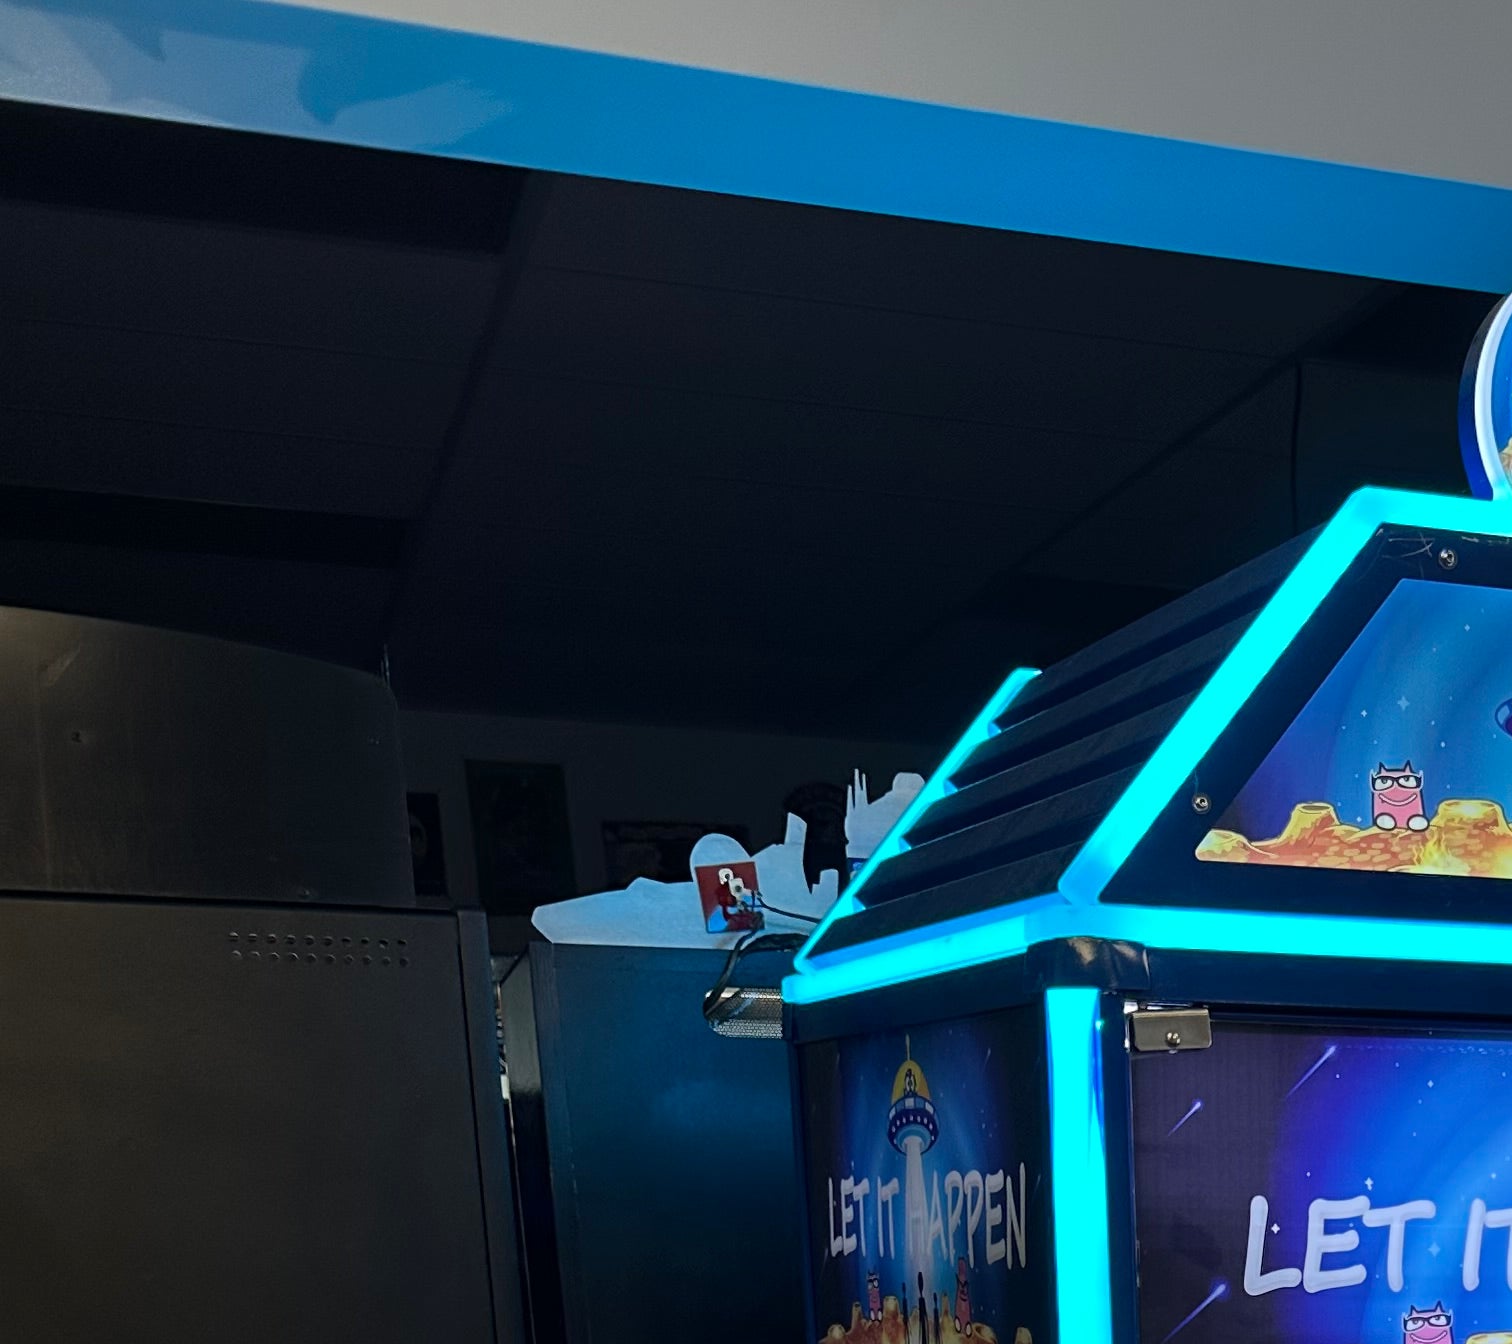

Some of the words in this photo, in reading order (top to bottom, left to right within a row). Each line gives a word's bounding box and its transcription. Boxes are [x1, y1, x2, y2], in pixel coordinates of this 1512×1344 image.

[828, 1175, 870, 1260] LET
[875, 1175, 899, 1262] IT
[905, 1161, 1027, 1271] HAPPEN
[1242, 1192, 1436, 1296] LET
